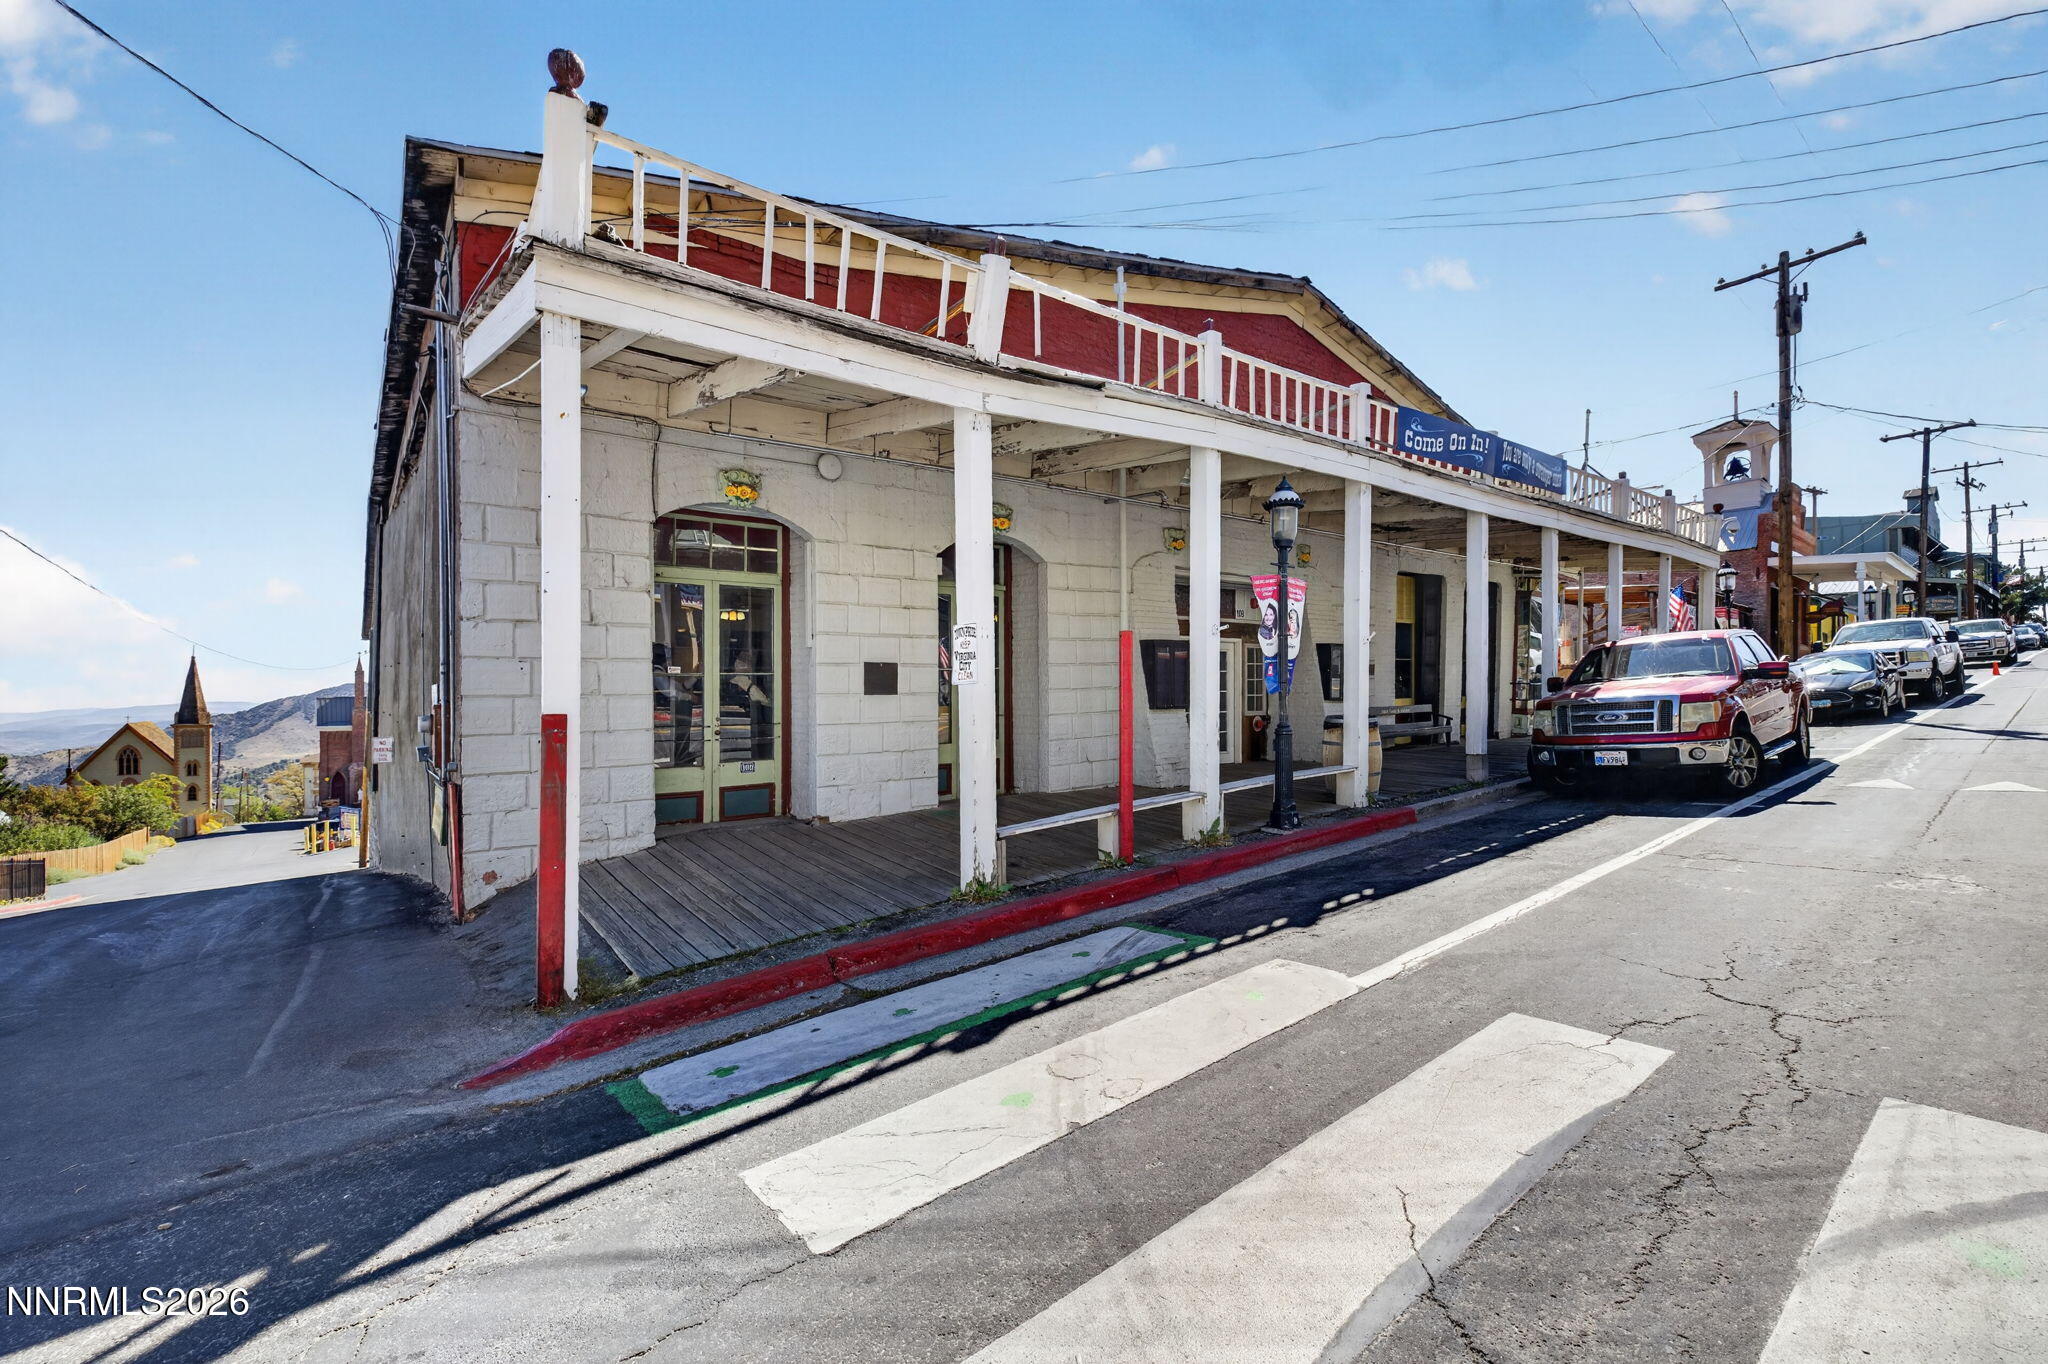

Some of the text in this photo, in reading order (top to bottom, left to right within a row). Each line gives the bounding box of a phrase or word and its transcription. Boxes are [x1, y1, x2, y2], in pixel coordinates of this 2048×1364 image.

[1405, 429, 1489, 454] Come On In!
